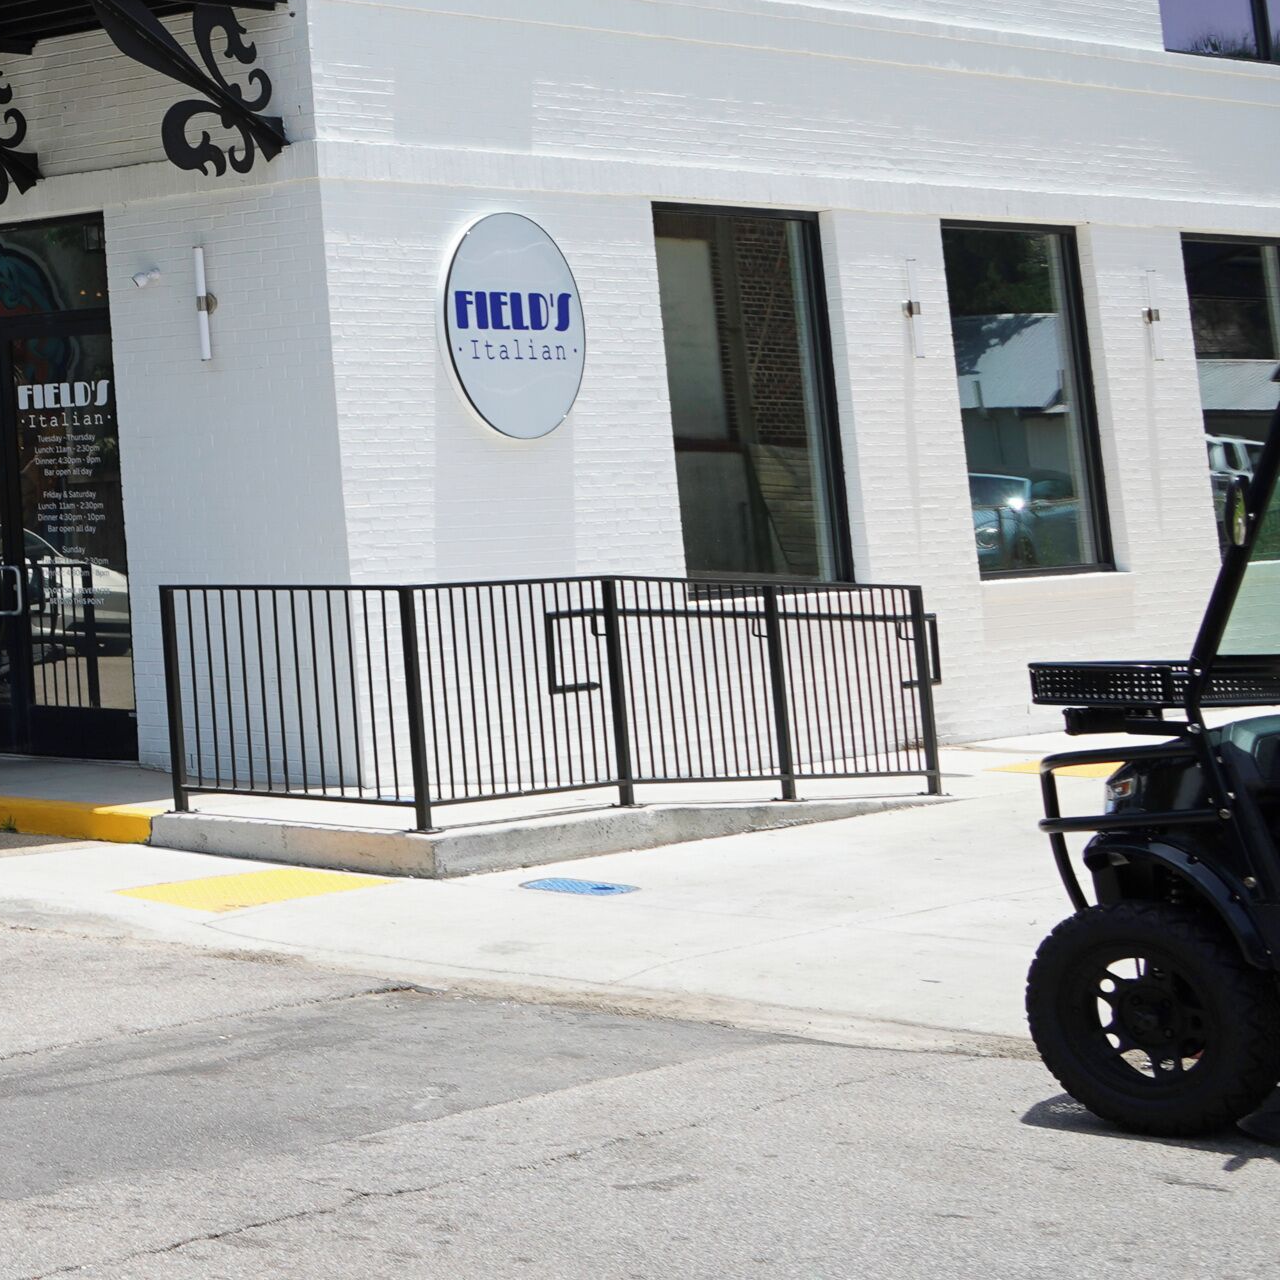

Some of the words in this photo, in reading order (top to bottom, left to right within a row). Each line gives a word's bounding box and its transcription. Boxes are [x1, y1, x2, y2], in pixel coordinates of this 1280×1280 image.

[454, 290, 572, 332] FIELD'S
[471, 339, 567, 361] Italian
[17, 379, 110, 410] FIELD'S
[28, 411, 104, 428] Italian
[66, 433, 96, 442] Thursday
[55, 469, 72, 477] open
[80, 468, 93, 477] day
[43, 490, 62, 499] Friday
[69, 490, 97, 499] Saturday
[59, 526, 75, 534] open
[84, 525, 97, 534] day
[62, 545, 85, 554] Sunday
